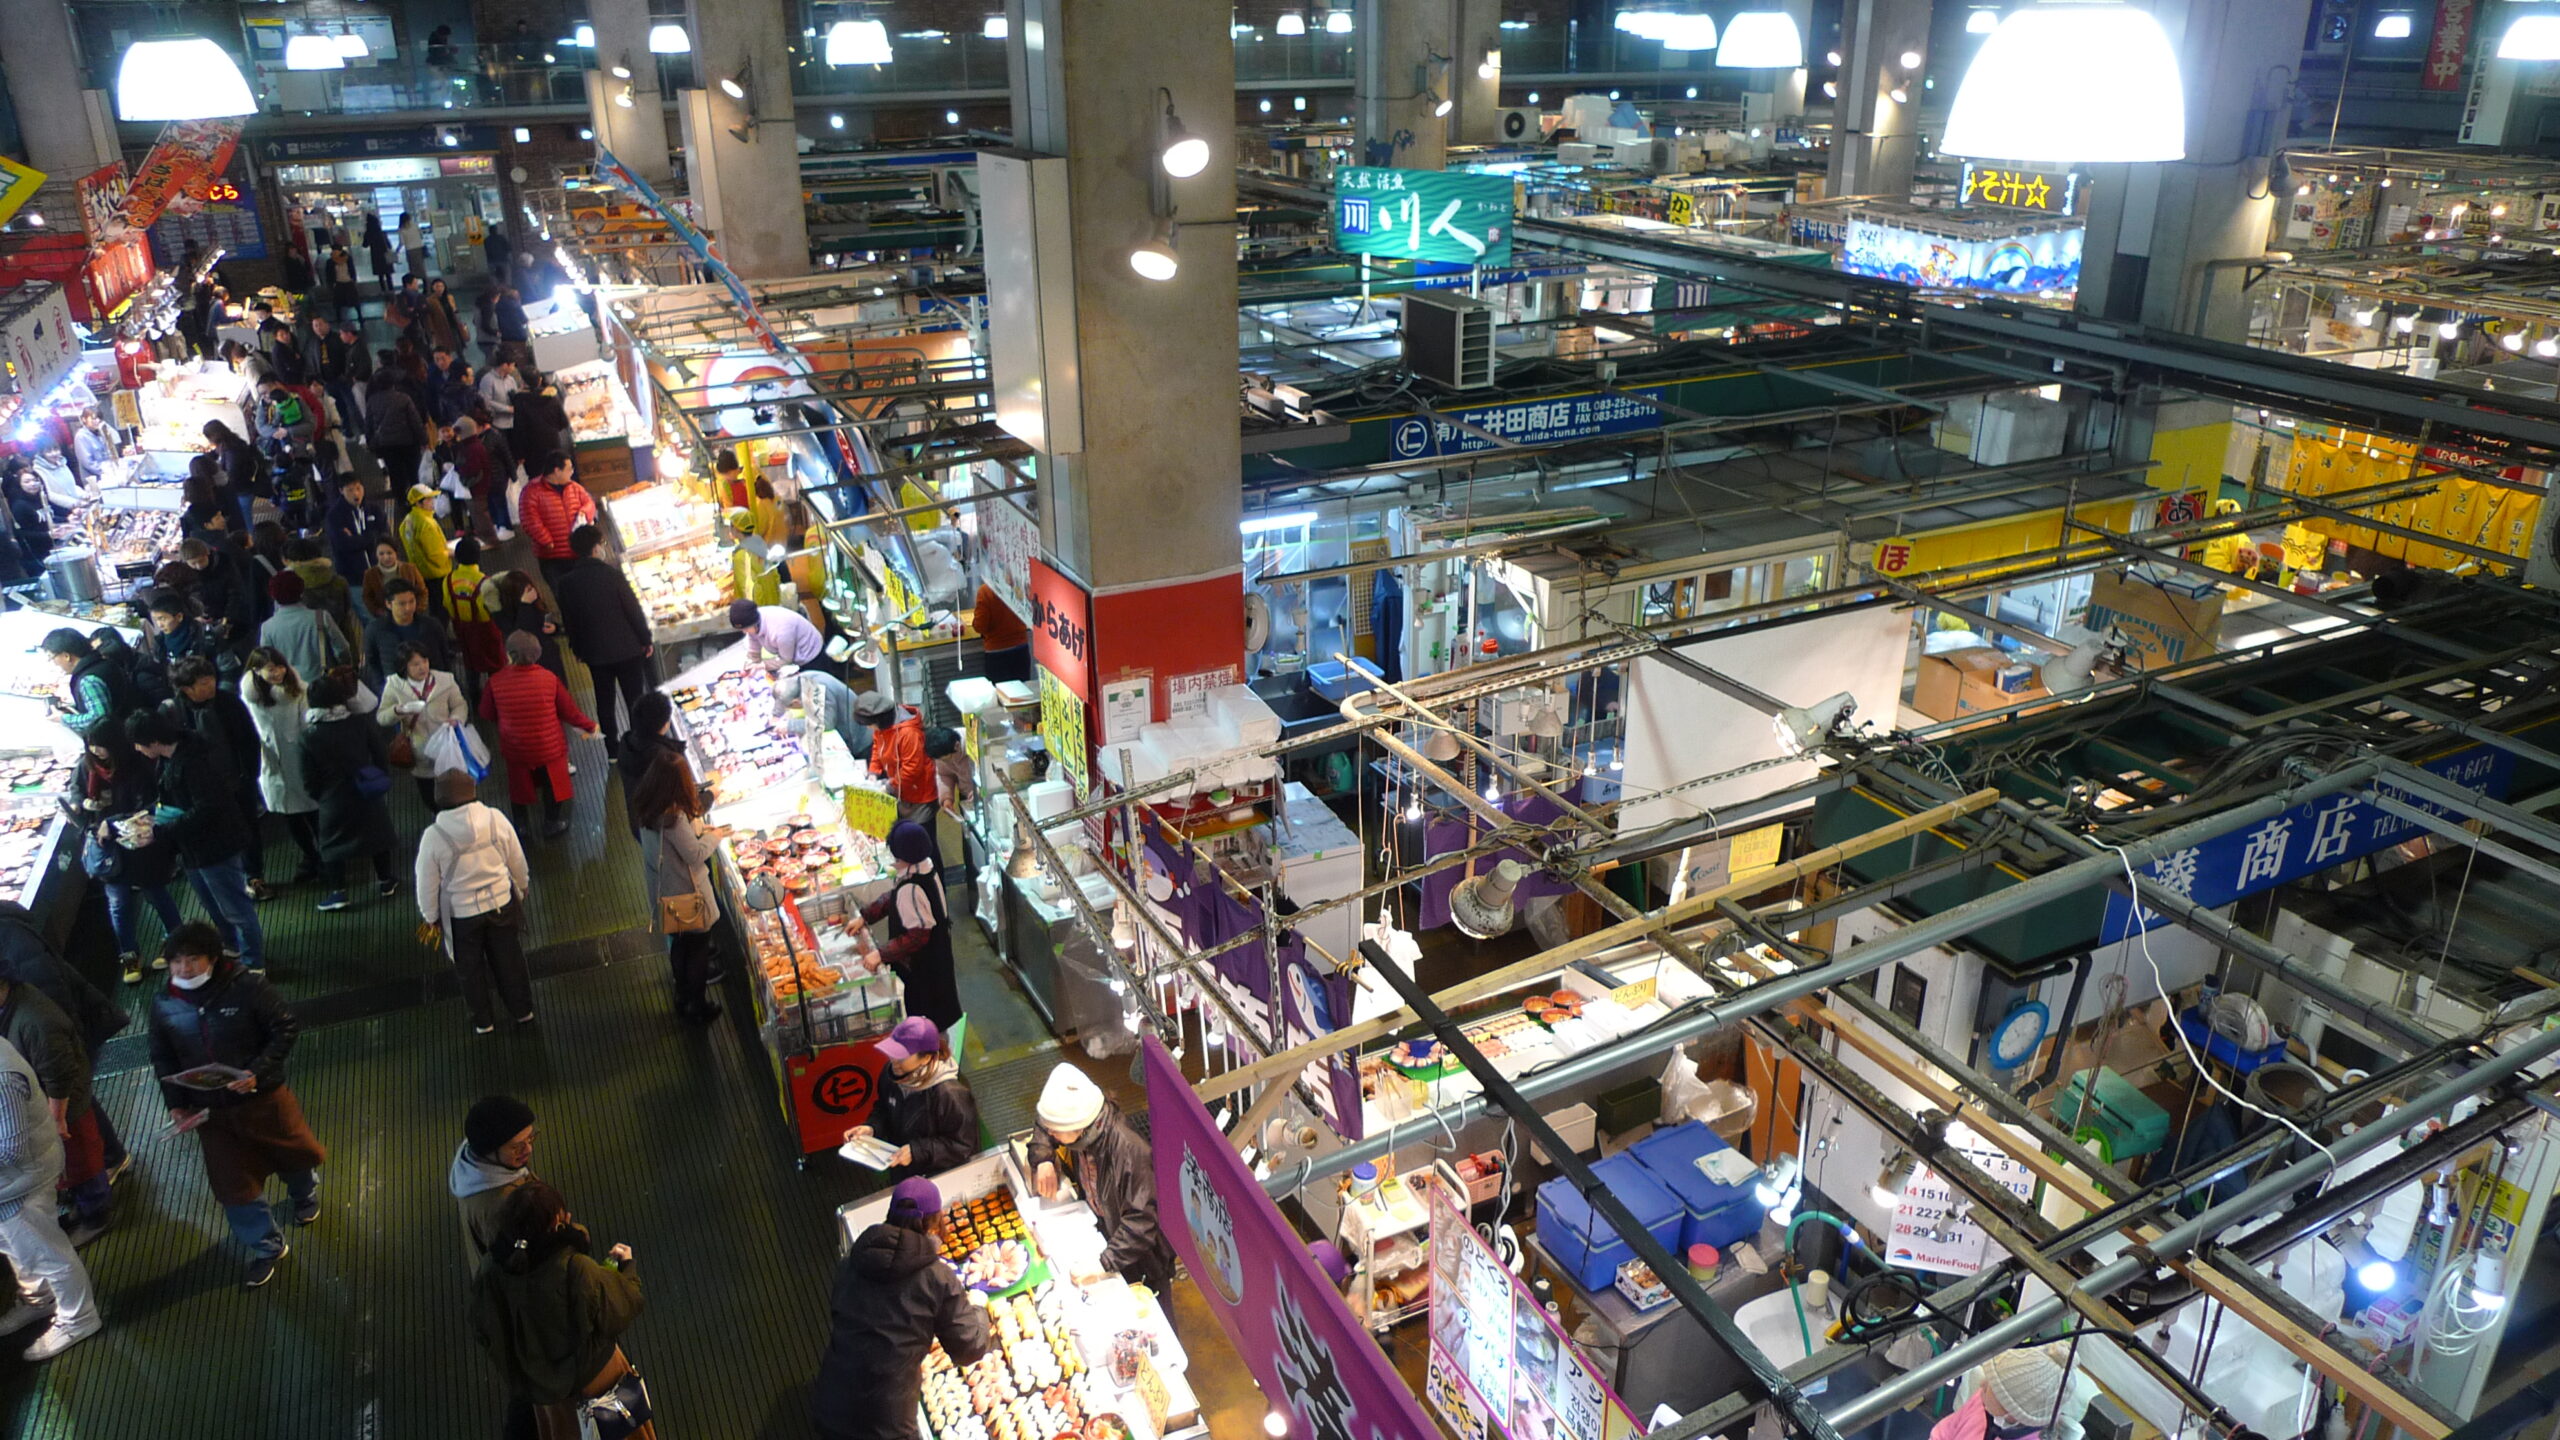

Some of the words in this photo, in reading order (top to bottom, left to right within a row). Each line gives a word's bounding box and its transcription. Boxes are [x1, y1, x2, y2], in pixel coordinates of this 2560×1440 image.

[1576, 402, 1592, 413] TEL
[1575, 412, 1591, 424] FAX
[1877, 543, 1911, 572] ほ
[1032, 593, 1085, 662] からあげ
[1172, 671, 1234, 696] 場内禁煙
[1983, 1158, 1991, 1169] 4
[2001, 1160, 2010, 1171] 5
[1904, 1185, 1918, 1197] 14
[1920, 1188, 1936, 1200] 15
[2012, 1183, 2029, 1196] 13
[1898, 1204, 1914, 1217] 21
[1916, 1206, 1932, 1219] 22
[1896, 1223, 1912, 1236] 28
[1913, 1226, 1930, 1239] 29
[1569, 1357, 1603, 1405] アジ
